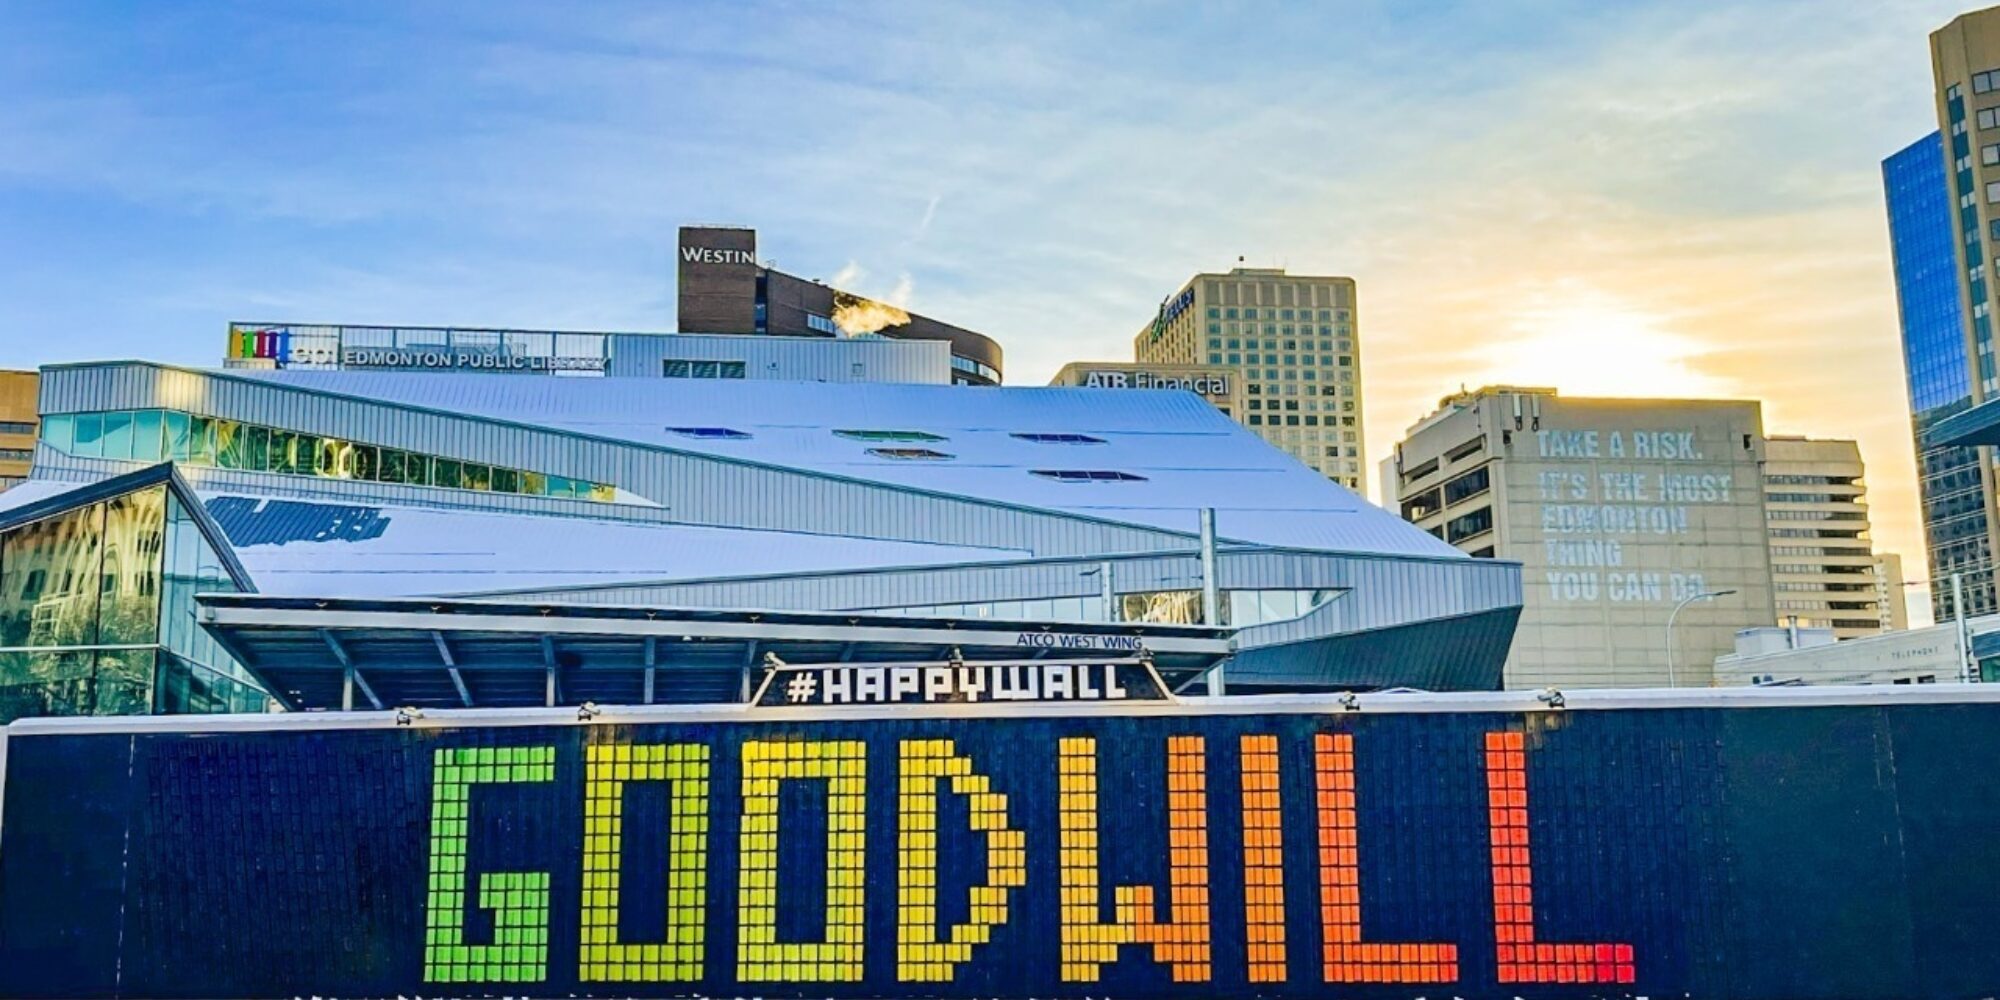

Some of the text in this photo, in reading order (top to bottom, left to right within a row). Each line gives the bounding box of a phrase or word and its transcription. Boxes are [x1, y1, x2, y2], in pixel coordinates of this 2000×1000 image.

[343, 350, 451, 367] EDMONTON
[457, 353, 525, 368] PUBLIC
[1086, 371, 1230, 394] ATB Financial
[1536, 430, 1703, 459] TAKE A RISK.
[1538, 471, 1732, 502] IT'S THE MOST
[1542, 504, 1688, 534] EDMONTON
[1545, 539, 1622, 566] THING
[1547, 572, 1599, 600] YOU
[1608, 572, 1662, 600] CAN
[1017, 633, 1143, 649] ATCO WEST WING
[787, 665, 1127, 703] #HAPPYWALL
[424, 731, 1635, 985] GOODWILL
